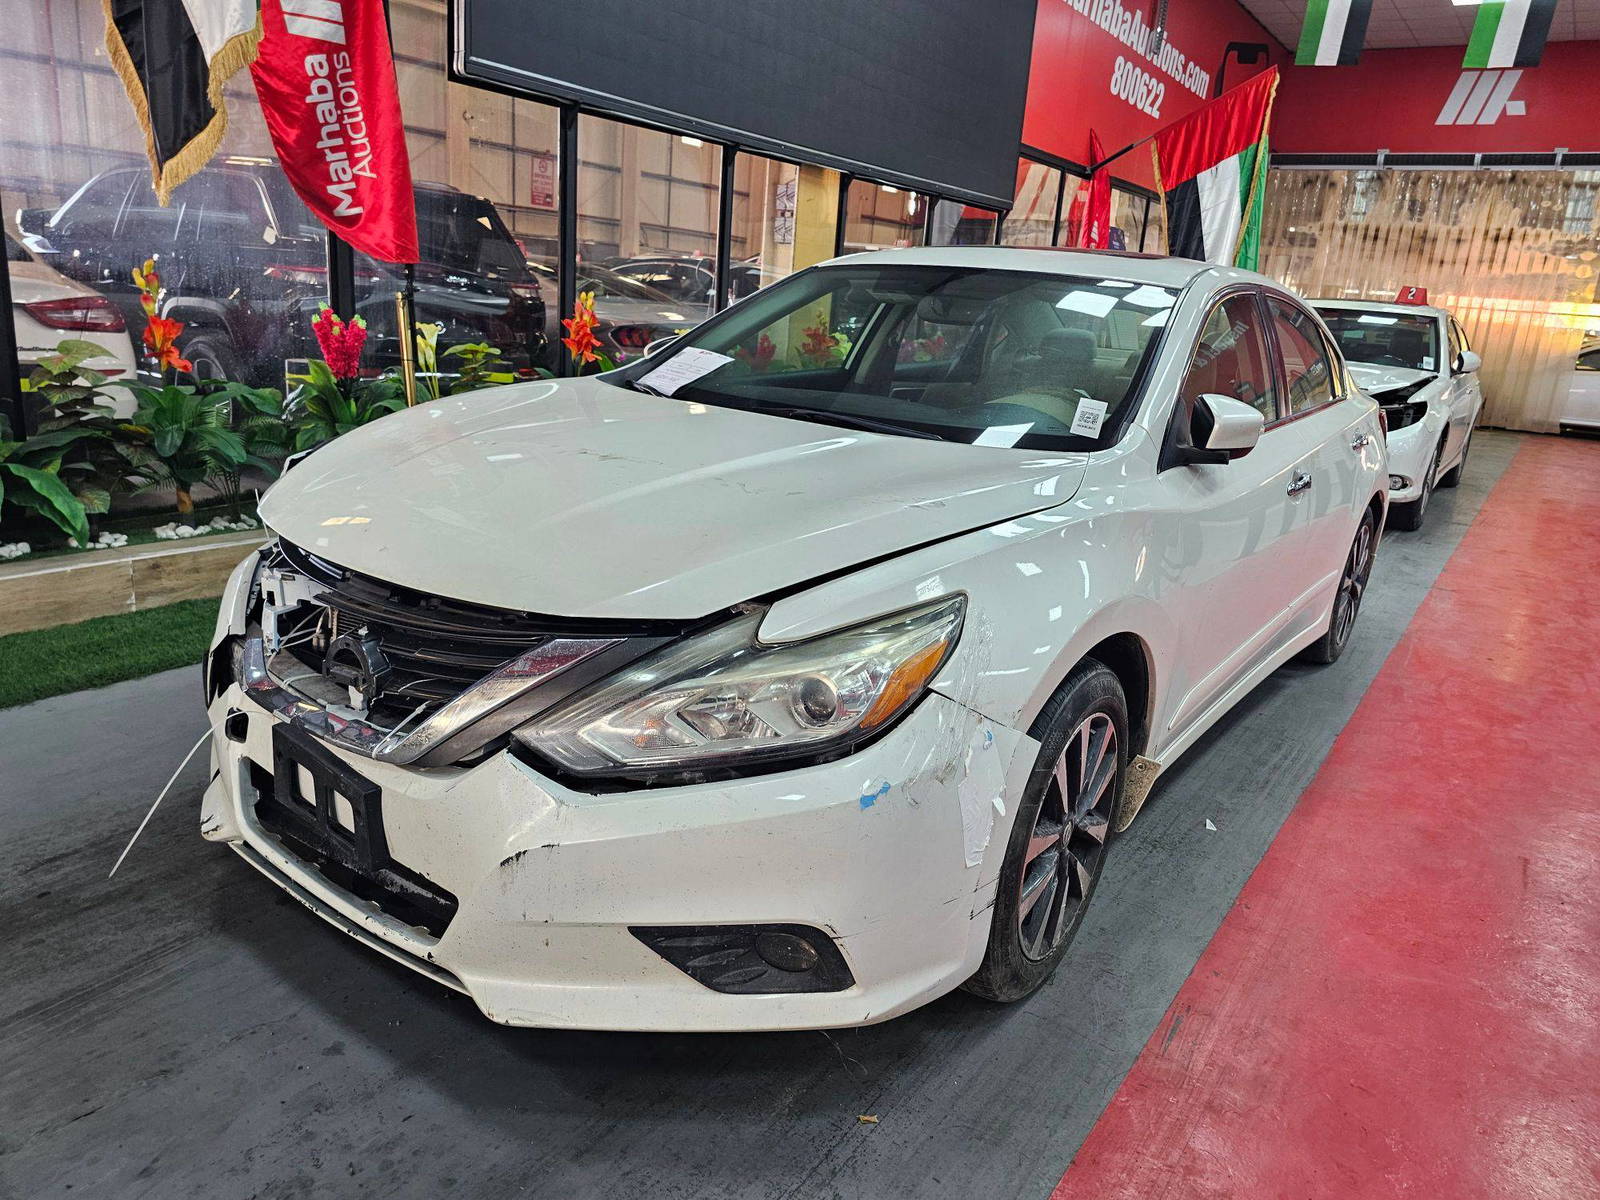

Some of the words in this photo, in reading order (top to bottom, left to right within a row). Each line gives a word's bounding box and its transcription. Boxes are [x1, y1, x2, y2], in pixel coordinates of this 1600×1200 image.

[1061, 0, 1210, 100] habaAucions.com
[1110, 55, 1166, 120] 800622
[304, 53, 364, 217] Marhaba
[333, 51, 377, 179] Auctions
[1408, 287, 1417, 300] 2
